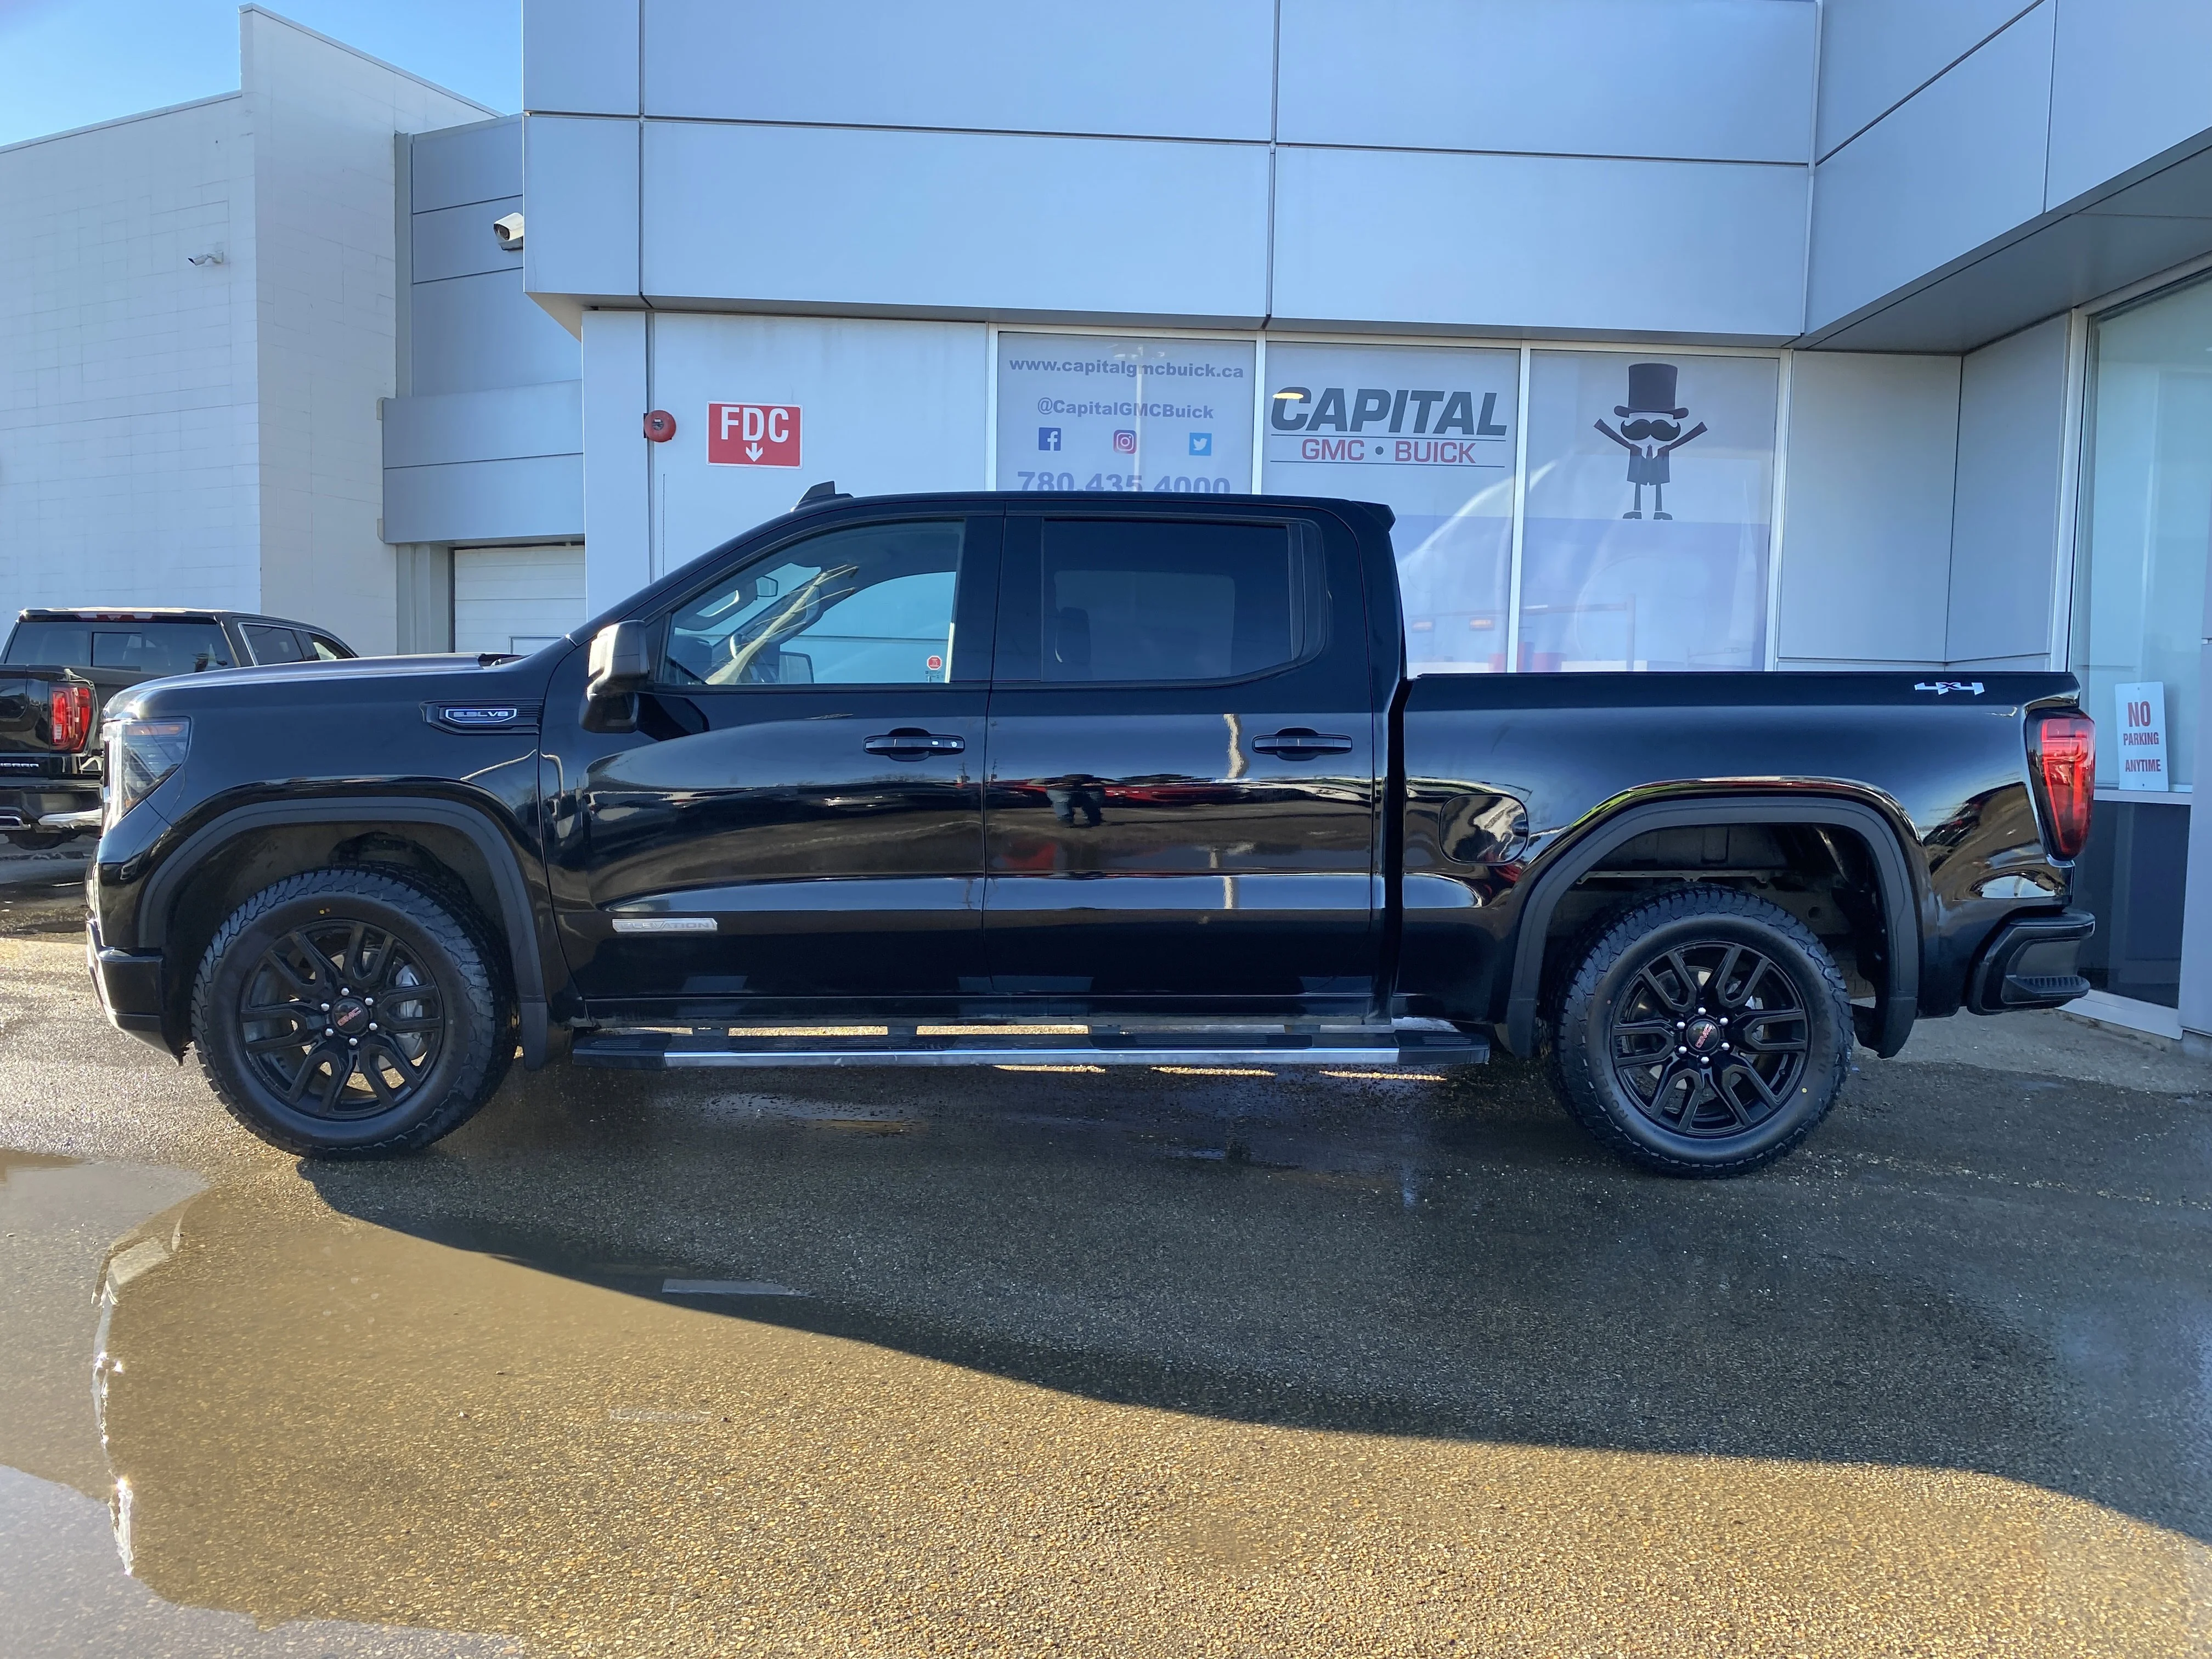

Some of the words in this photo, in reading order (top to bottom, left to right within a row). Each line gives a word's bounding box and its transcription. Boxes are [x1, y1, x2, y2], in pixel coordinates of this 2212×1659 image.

[1009, 360, 1244, 378] www.capitalgmcbuick.ca
[1037, 397, 1214, 419] @CapitalGMCBuick
[1271, 386, 1508, 436] CAPITAL
[721, 406, 789, 443] FDC
[1302, 438, 1365, 461] GMC
[1395, 441, 1476, 464] BUICK
[1017, 471, 1231, 494] 7804354000
[2128, 701, 2151, 727] NO
[2123, 732, 2159, 746] PARKING
[2125, 759, 2162, 772] ANYTIME
[620, 921, 710, 929] ELEVATION
[337, 1007, 362, 1026] GMC
[1695, 1023, 1713, 1048] GMC
